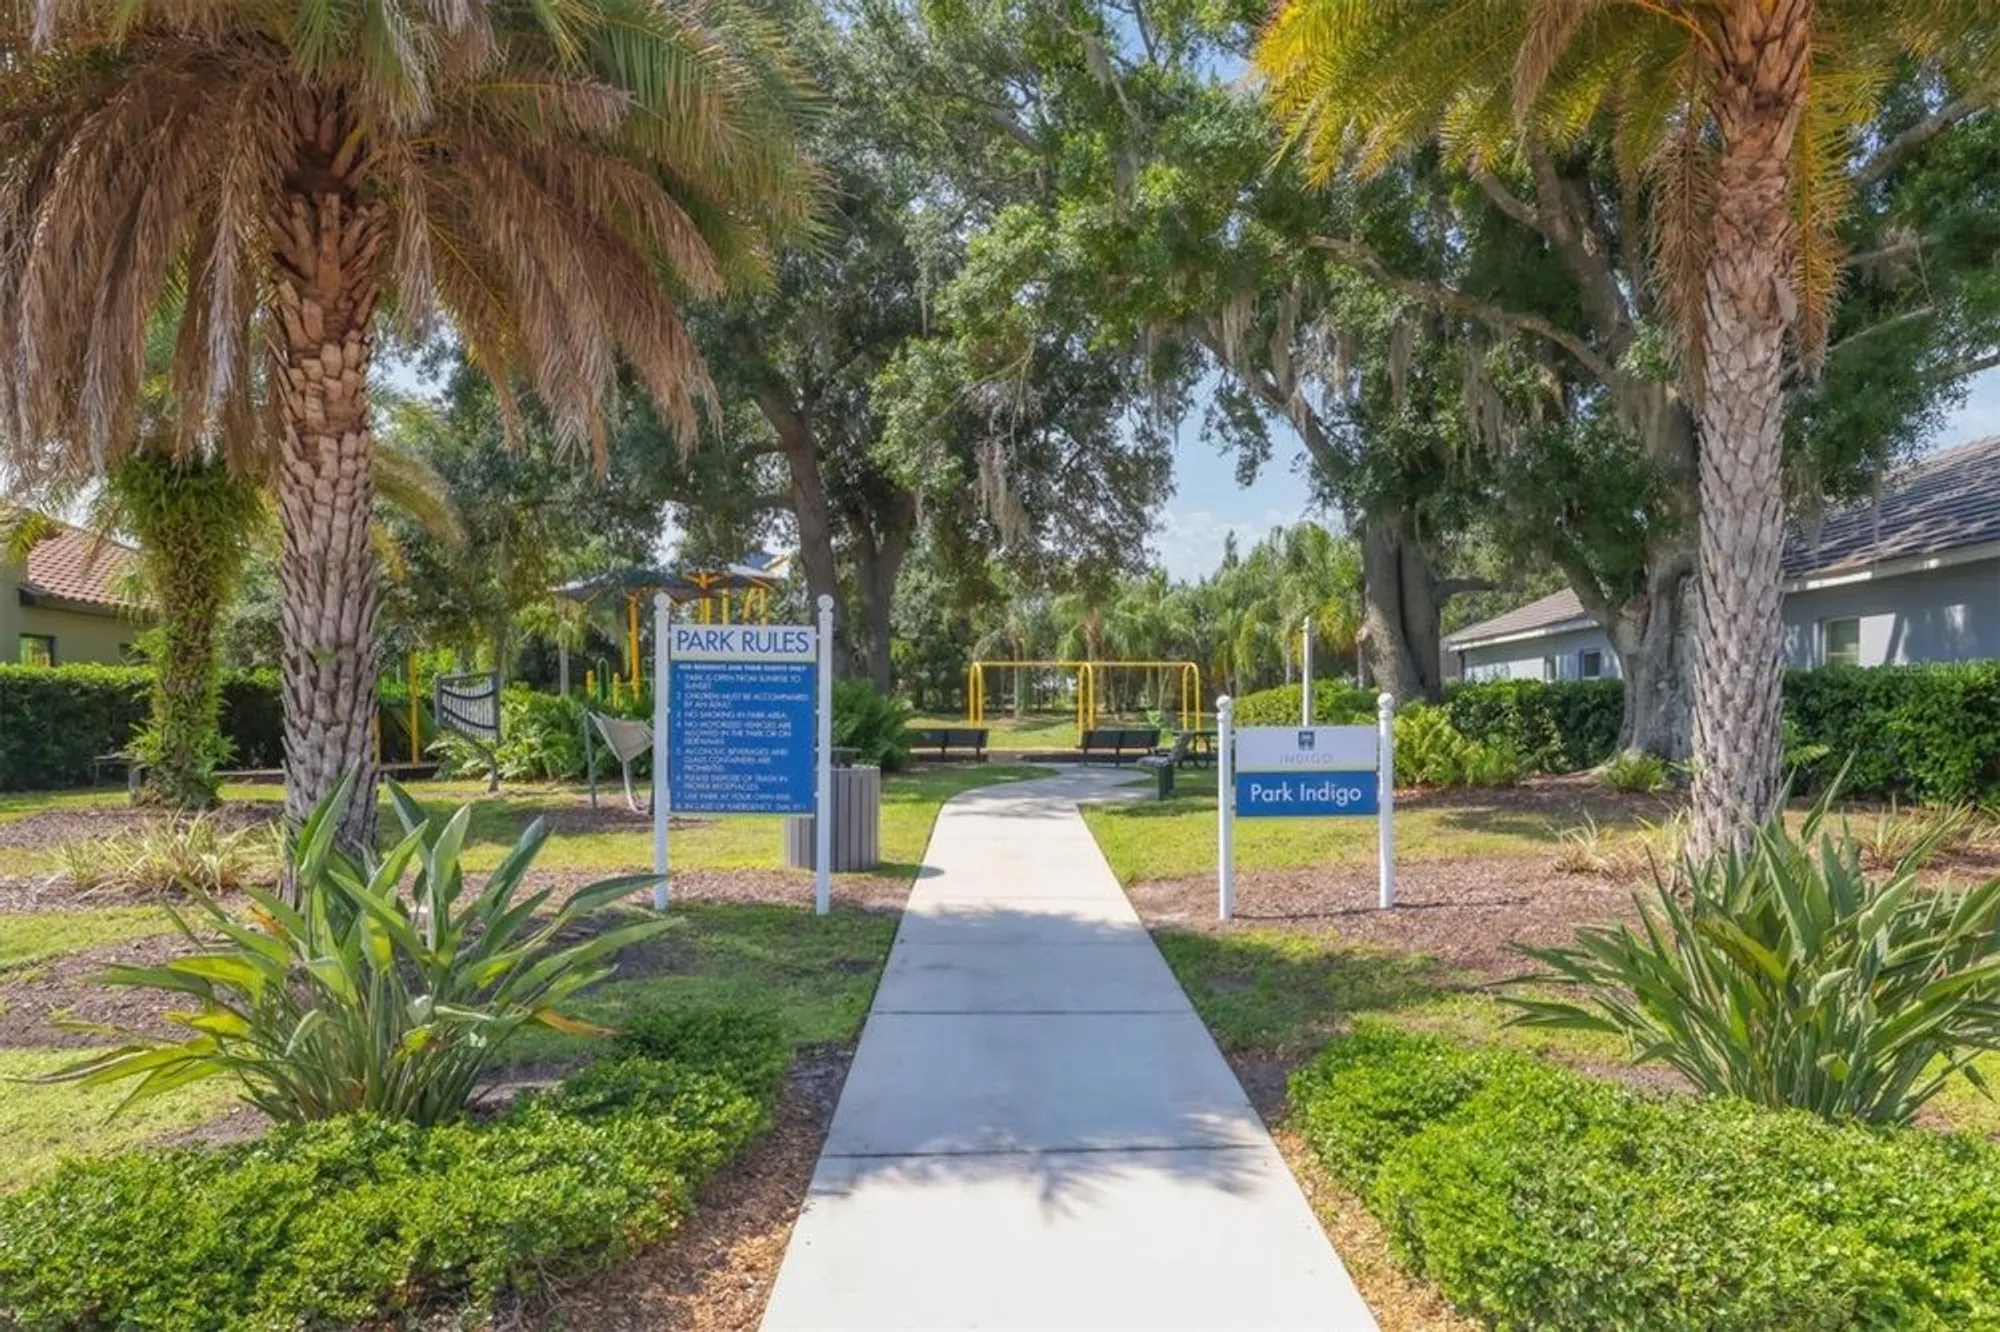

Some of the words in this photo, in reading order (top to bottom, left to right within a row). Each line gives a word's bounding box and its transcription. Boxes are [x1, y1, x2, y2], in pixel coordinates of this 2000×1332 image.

[677, 630, 734, 651] PARK
[742, 631, 809, 653] RULES
[1280, 753, 1331, 765] INDIGO
[1250, 782, 1294, 802] Park
[1300, 781, 1362, 807] Indigo
